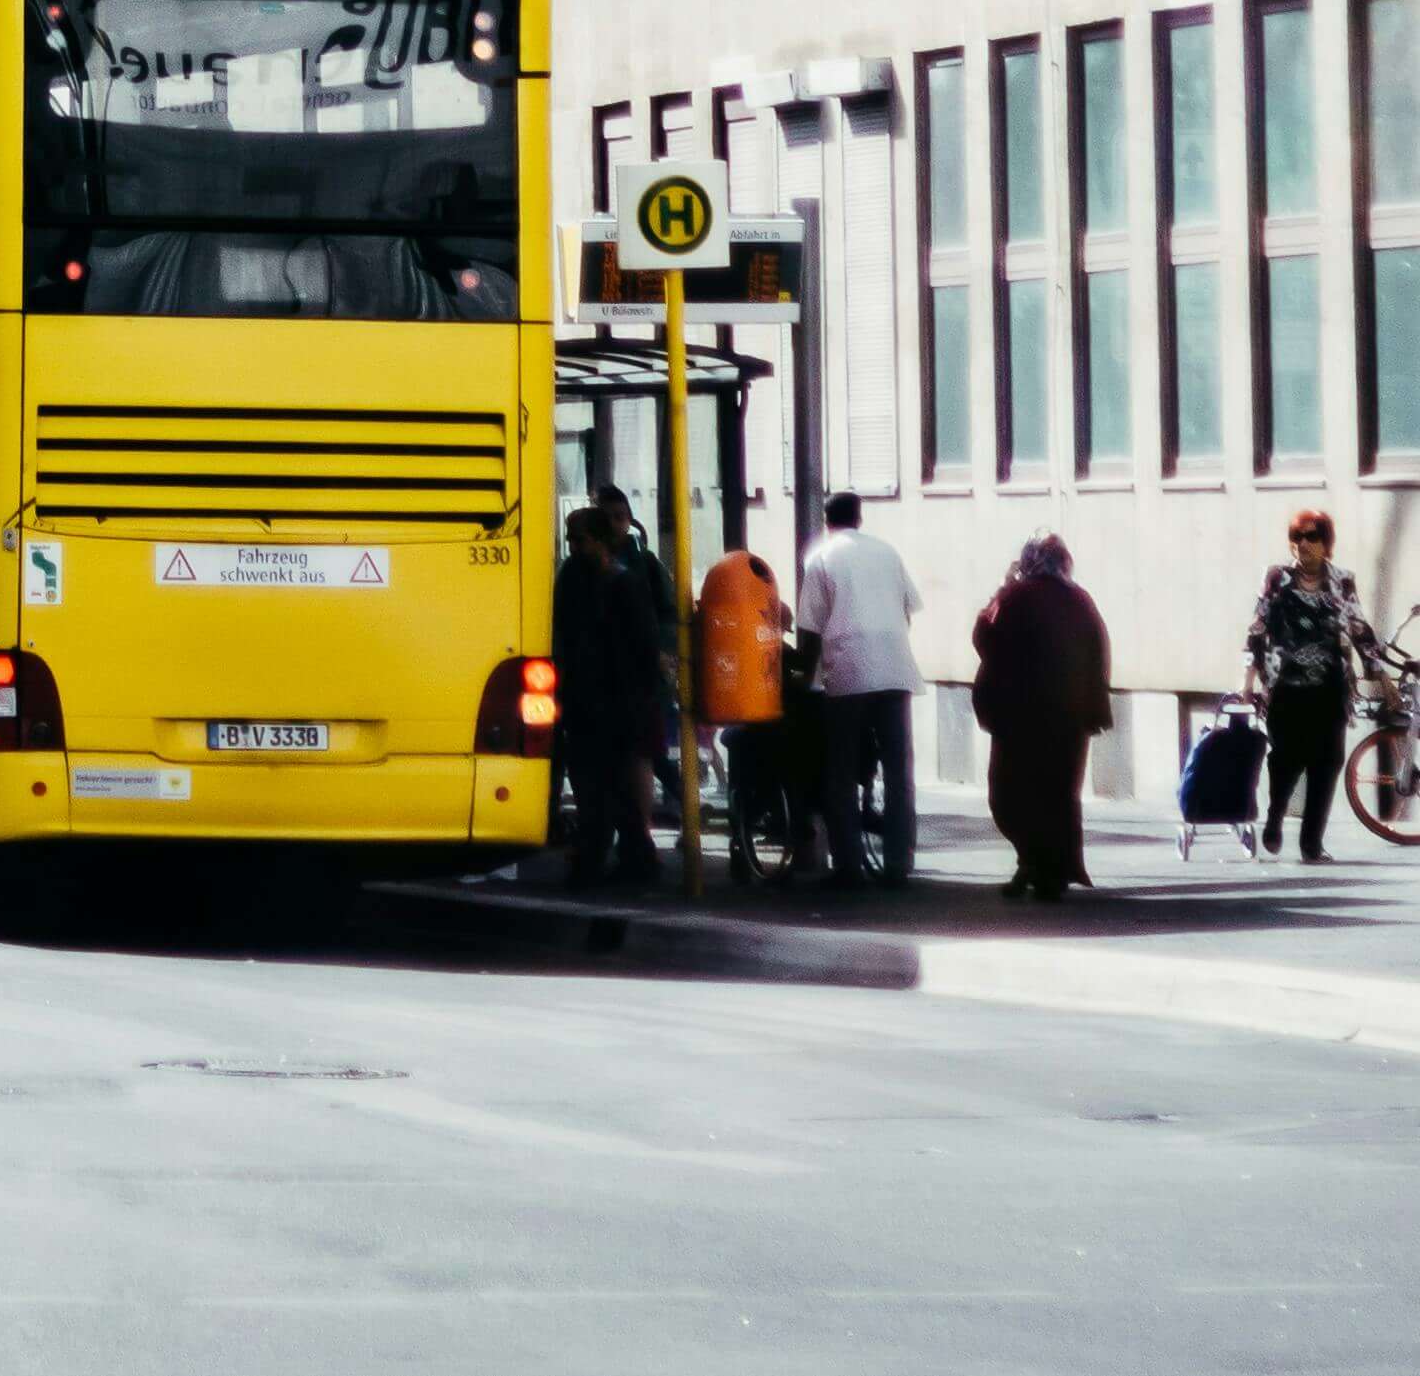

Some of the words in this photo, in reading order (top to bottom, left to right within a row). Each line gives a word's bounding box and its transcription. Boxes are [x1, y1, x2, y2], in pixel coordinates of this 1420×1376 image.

[659, 194, 695, 237] H
[730, 229, 769, 240] Abfahrt
[237, 548, 309, 568] Fahrzeug
[467, 546, 511, 566] 3330
[219, 567, 294, 584] schwenkt
[299, 571, 326, 584] aus
[226, 726, 239, 746] B
[251, 726, 266, 746] V
